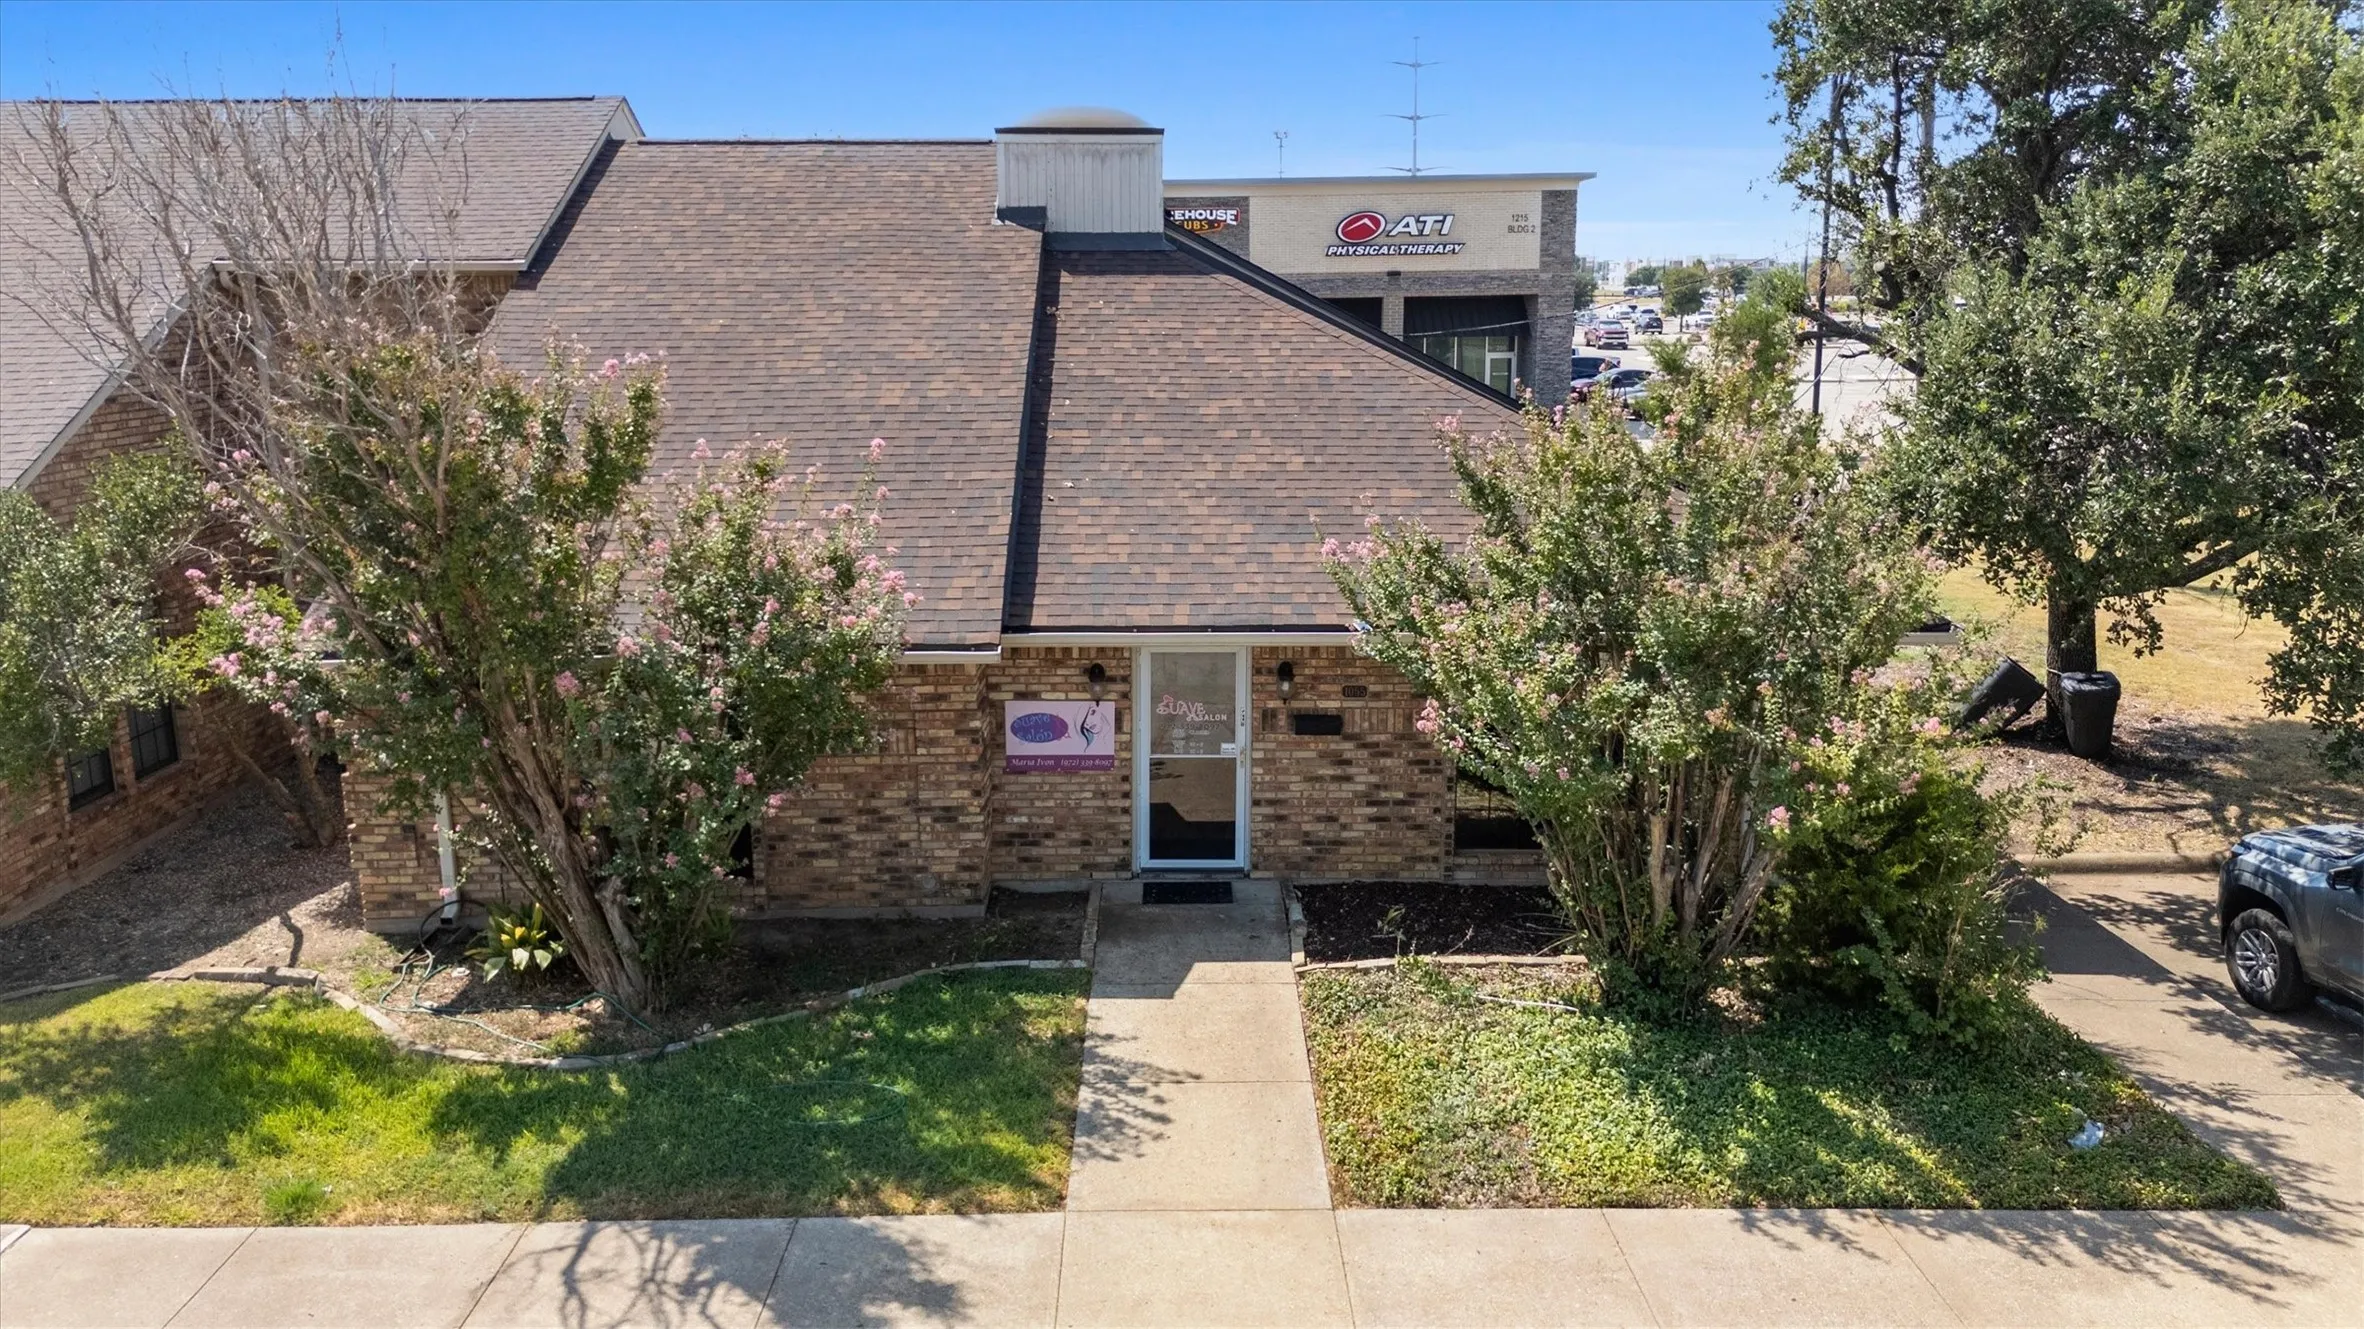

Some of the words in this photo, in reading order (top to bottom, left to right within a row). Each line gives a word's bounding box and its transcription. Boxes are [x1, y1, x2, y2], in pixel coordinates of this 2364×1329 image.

[1171, 210, 1238, 226] EHOUSE
[1386, 213, 1456, 237] ATI
[1511, 214, 1529, 223] 1215
[1507, 224, 1529, 234] BLDG
[1530, 224, 1536, 234] 2
[1326, 244, 1398, 257] PHYSICAL
[1397, 242, 1466, 256] THERAPY
